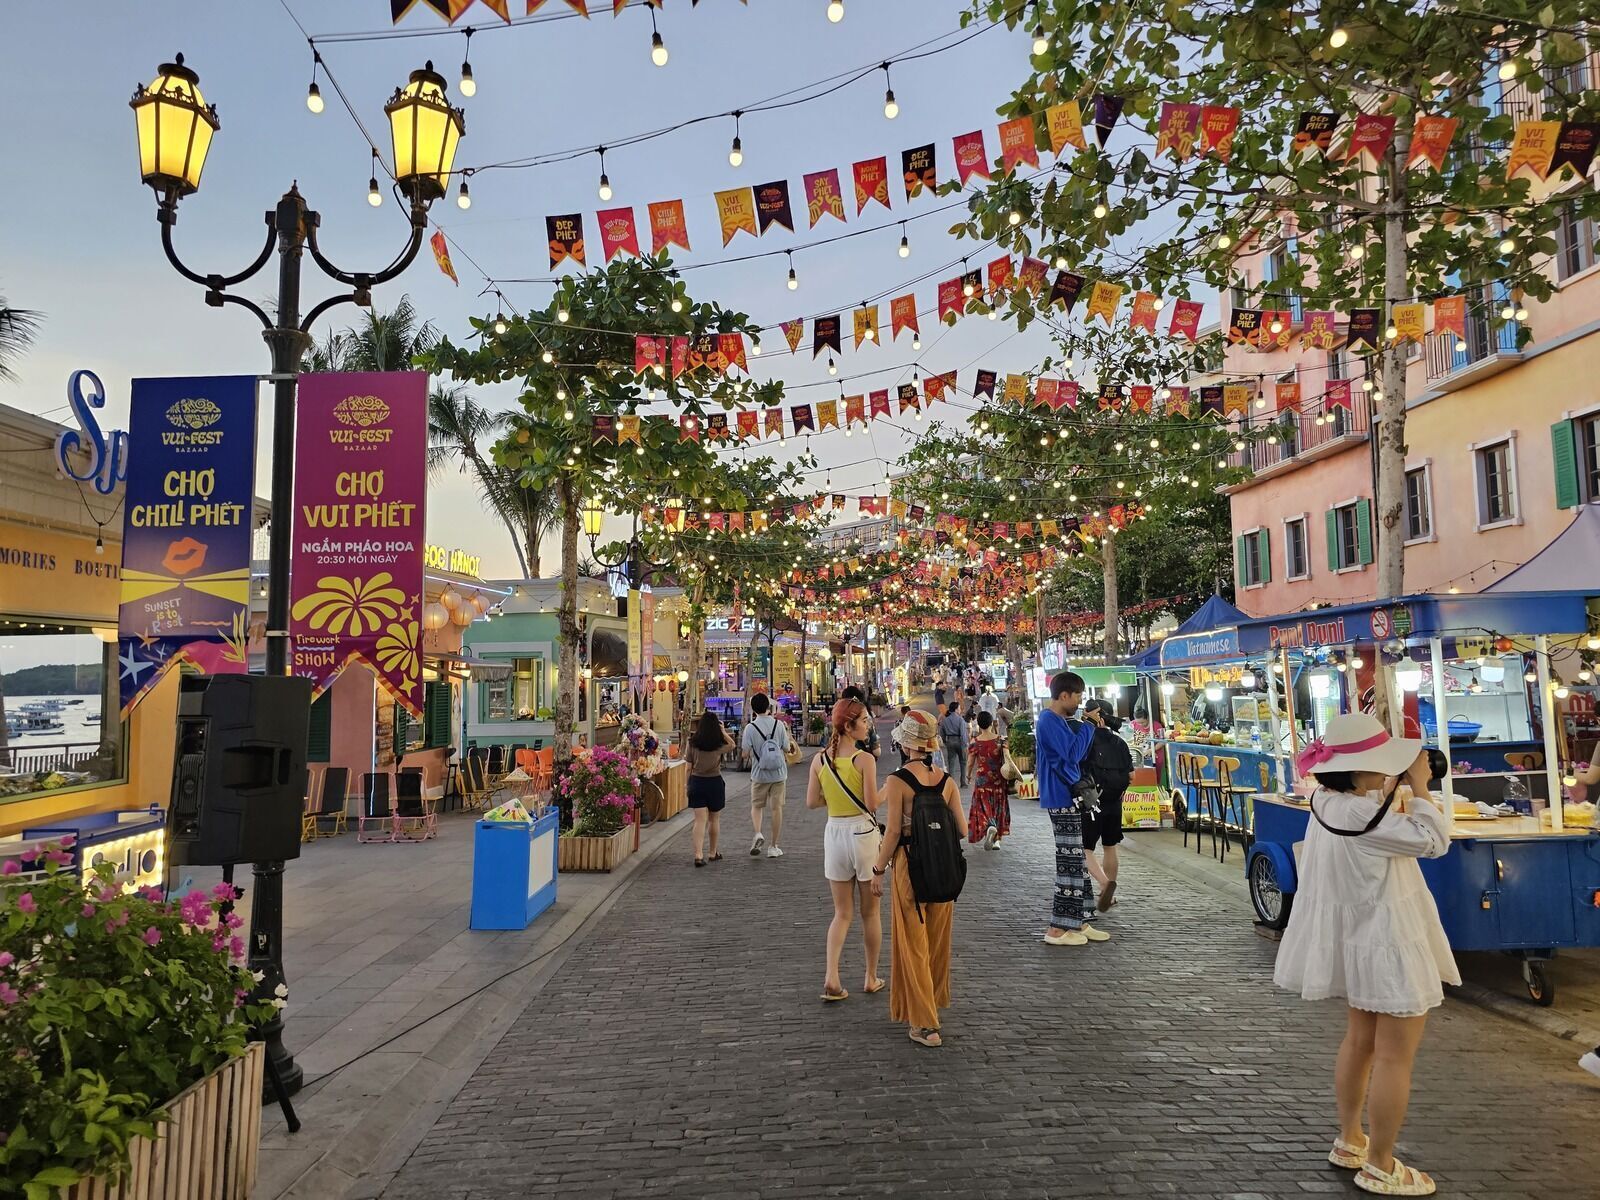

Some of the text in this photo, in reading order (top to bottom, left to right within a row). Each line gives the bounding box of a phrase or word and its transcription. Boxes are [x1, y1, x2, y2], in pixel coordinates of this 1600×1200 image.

[1055, 110, 1070, 120] VUI
[1171, 110, 1190, 120] SAY
[1525, 128, 1546, 138] VUI
[723, 195, 741, 207] VUI
[163, 467, 215, 501] CHỢ
[335, 469, 385, 501] CHỢ
[131, 499, 186, 527] CHILL
[302, 499, 417, 528] VUI PHẾT
[344, 539, 383, 552] PHÁO
[385, 541, 415, 552] HOA
[317, 555, 346, 564] 20:30
[370, 553, 399, 564] NGÀY
[74, 558, 121, 580] BOUTI
[144, 597, 182, 613] SUNSET
[1306, 616, 1346, 646] Puni
[296, 634, 341, 645] Firework
[1186, 638, 1231, 657] Vietnamese
[295, 654, 336, 667] SHOW
[1019, 777, 1039, 797] MÍ
